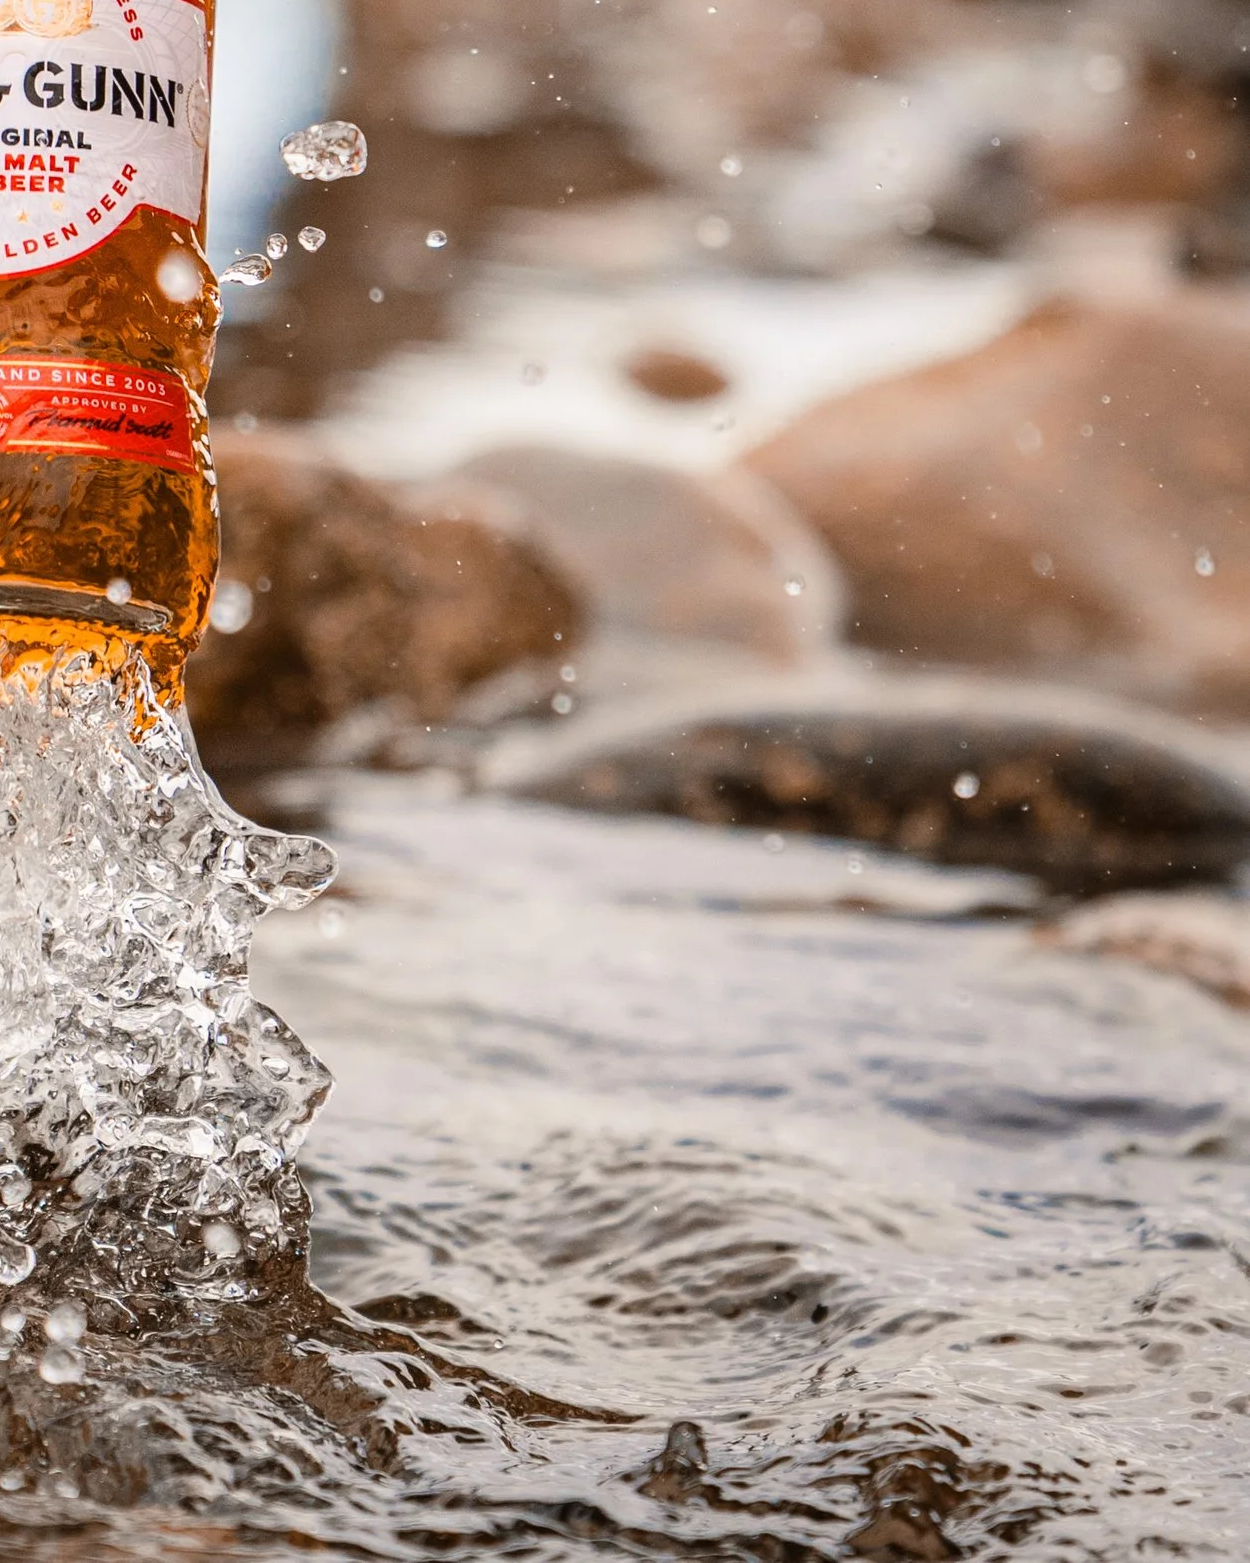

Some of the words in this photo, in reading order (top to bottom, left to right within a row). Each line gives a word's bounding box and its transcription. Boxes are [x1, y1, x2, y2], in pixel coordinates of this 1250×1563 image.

[4, 153, 81, 174] MALT
[85, 162, 138, 225] BEER
[51, 369, 116, 387] SINCE
[124, 377, 167, 397] 2003
[51, 396, 126, 411] APPROVED
[132, 403, 148, 414] BY
